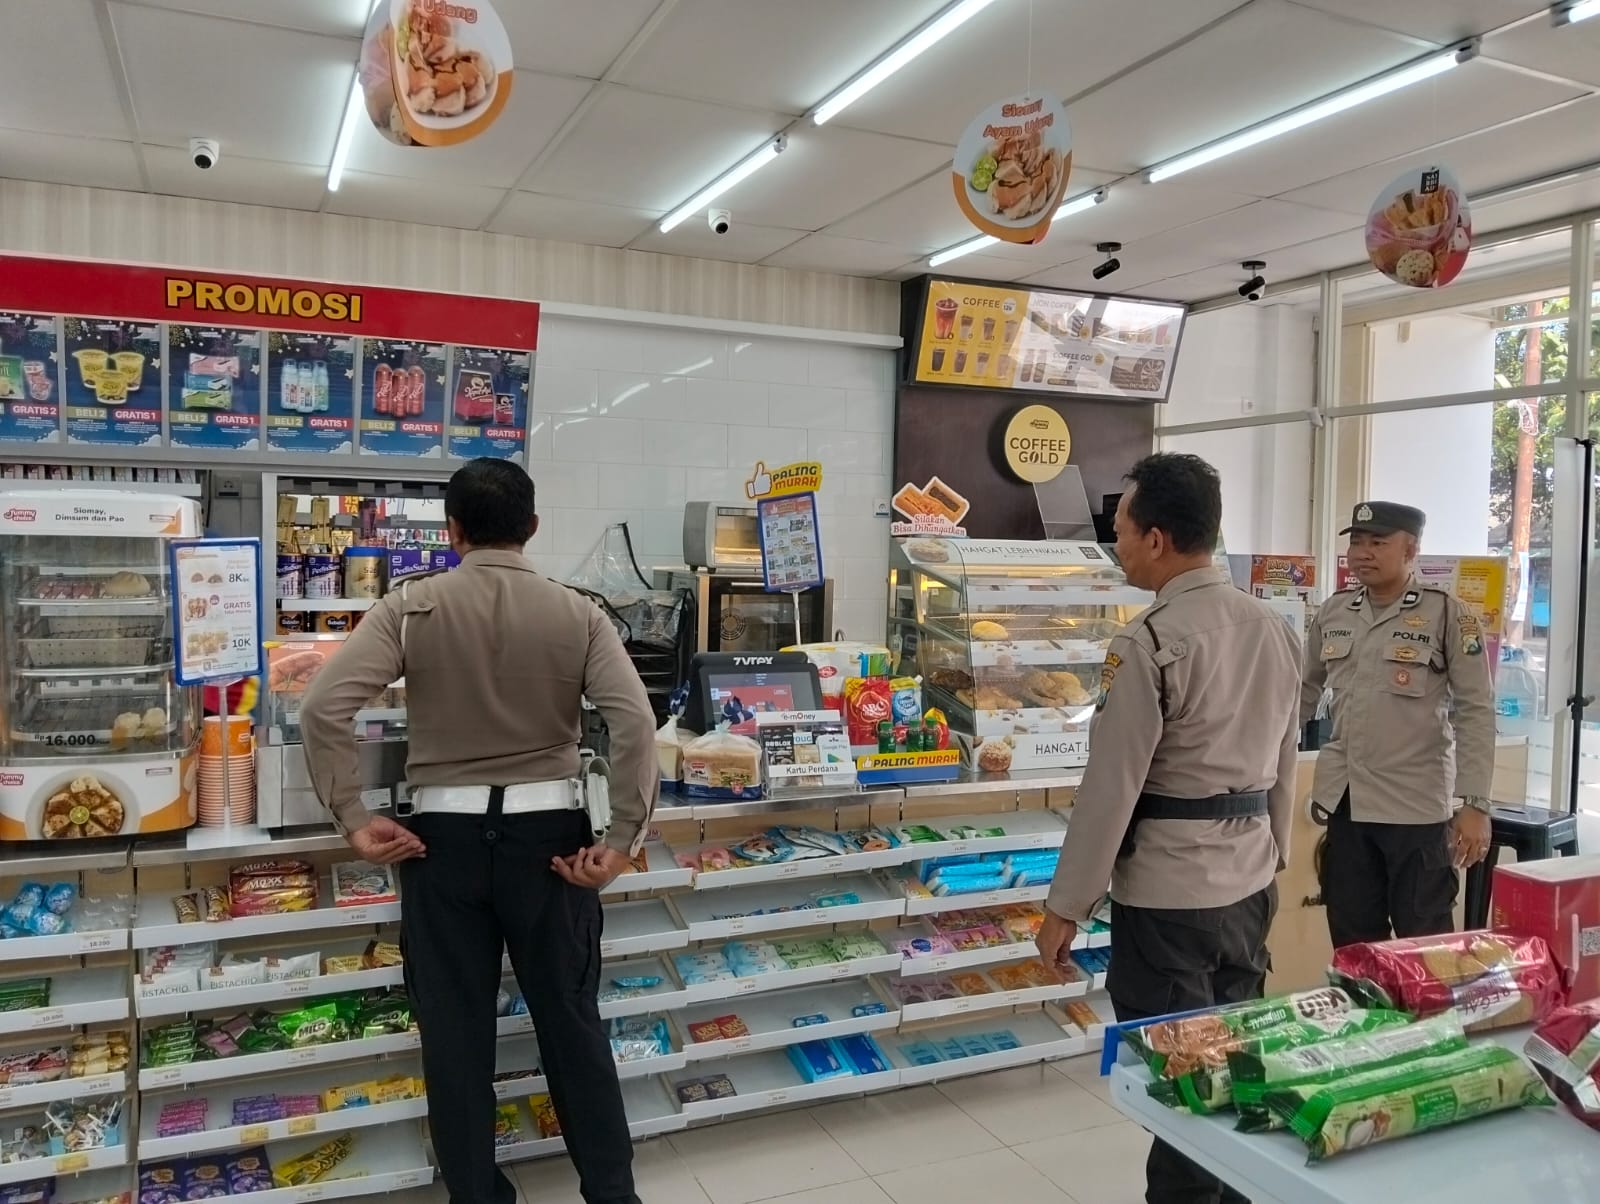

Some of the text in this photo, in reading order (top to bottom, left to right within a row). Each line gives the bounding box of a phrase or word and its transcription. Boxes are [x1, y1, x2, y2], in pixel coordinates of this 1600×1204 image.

[983, 124, 1022, 139] Ayam
[165, 277, 361, 321] PROMOSI
[963, 297, 1000, 309] COFFEE
[13, 405, 57, 415] GRATIS 2
[75, 408, 105, 418] BELI 2
[115, 410, 156, 420] GRATIS 1
[178, 413, 207, 423] BELI 2
[215, 415, 249, 425] GRATIS
[275, 417, 302, 427] BELI 2
[310, 419, 342, 428] GRATIS
[368, 421, 387, 430] BELI
[402, 423, 432, 433] GRATIS
[486, 429, 515, 438] GRATIS
[1010, 437, 1066, 452] COFFEE
[1018, 451, 1059, 465] GOLD
[773, 465, 817, 482] PALING
[775, 476, 818, 490] MURAH
[55, 514, 89, 522] Dimsum
[914, 515, 945, 524] Silakan
[893, 523, 965, 536] Bisa Dihangatkan
[960, 546, 1003, 554] HANGAT
[393, 563, 430, 576] PediaSure
[228, 573, 242, 583] 8K
[223, 601, 252, 610] GRATIS
[1393, 631, 1430, 643] POLRI
[232, 638, 252, 649] 10K
[46, 735, 96, 747] 16.000
[1035, 741, 1082, 756] HANGAT
[873, 755, 958, 768] PALING MURAH
[786, 765, 839, 774] Kartu Perdana
[298, 1021, 327, 1034] MILO
